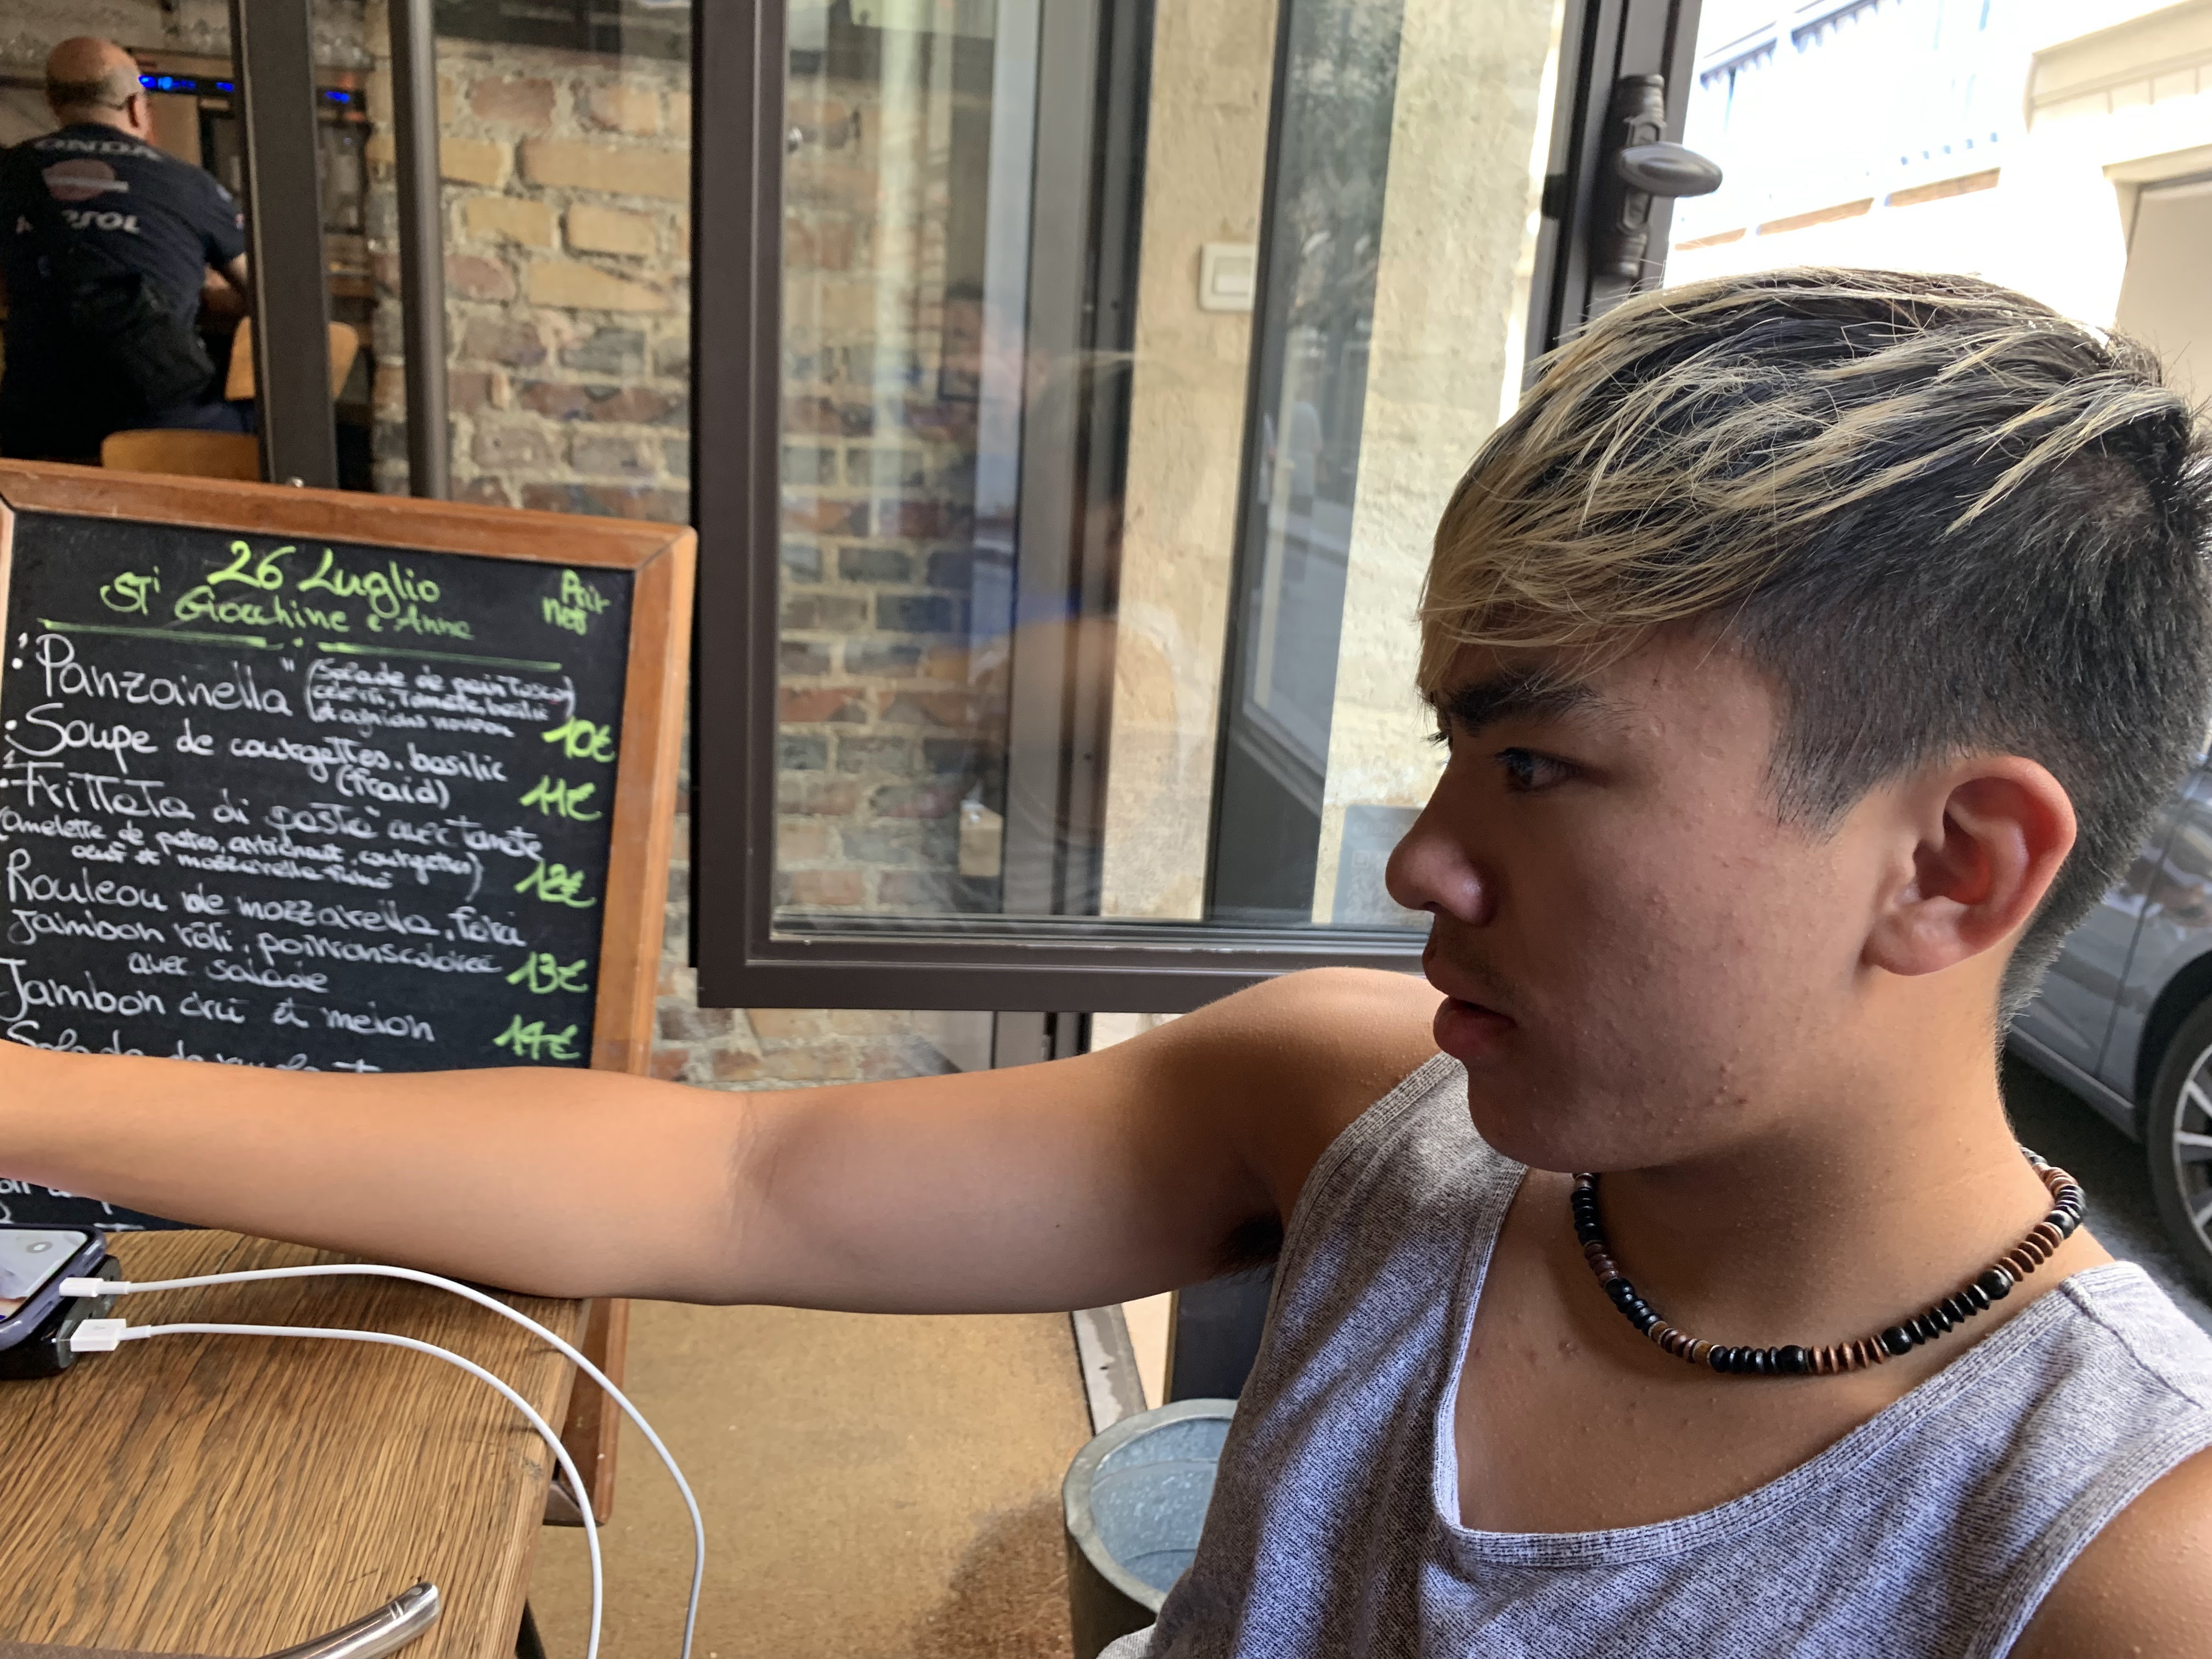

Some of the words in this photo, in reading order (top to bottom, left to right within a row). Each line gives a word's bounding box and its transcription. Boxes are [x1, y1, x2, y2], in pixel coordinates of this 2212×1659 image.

[208, 540, 297, 590] 26
[298, 548, 441, 619] Luglio
[415, 663, 445, 692] de
[4, 702, 159, 774] Soupe
[176, 718, 215, 755] de
[406, 742, 507, 782] basilic
[541, 716, 615, 763] 10€
[212, 788, 250, 825] di
[520, 775, 603, 821] 11€
[117, 820, 145, 845] de
[7, 848, 168, 912] Rouleau
[180, 882, 230, 915] de
[8, 909, 166, 945] Jambon
[127, 951, 194, 975] avec
[506, 951, 588, 994] 13€
[0, 957, 166, 1022] Jambon
[319, 1001, 436, 1042] melon
[493, 1014, 580, 1060] 14€
